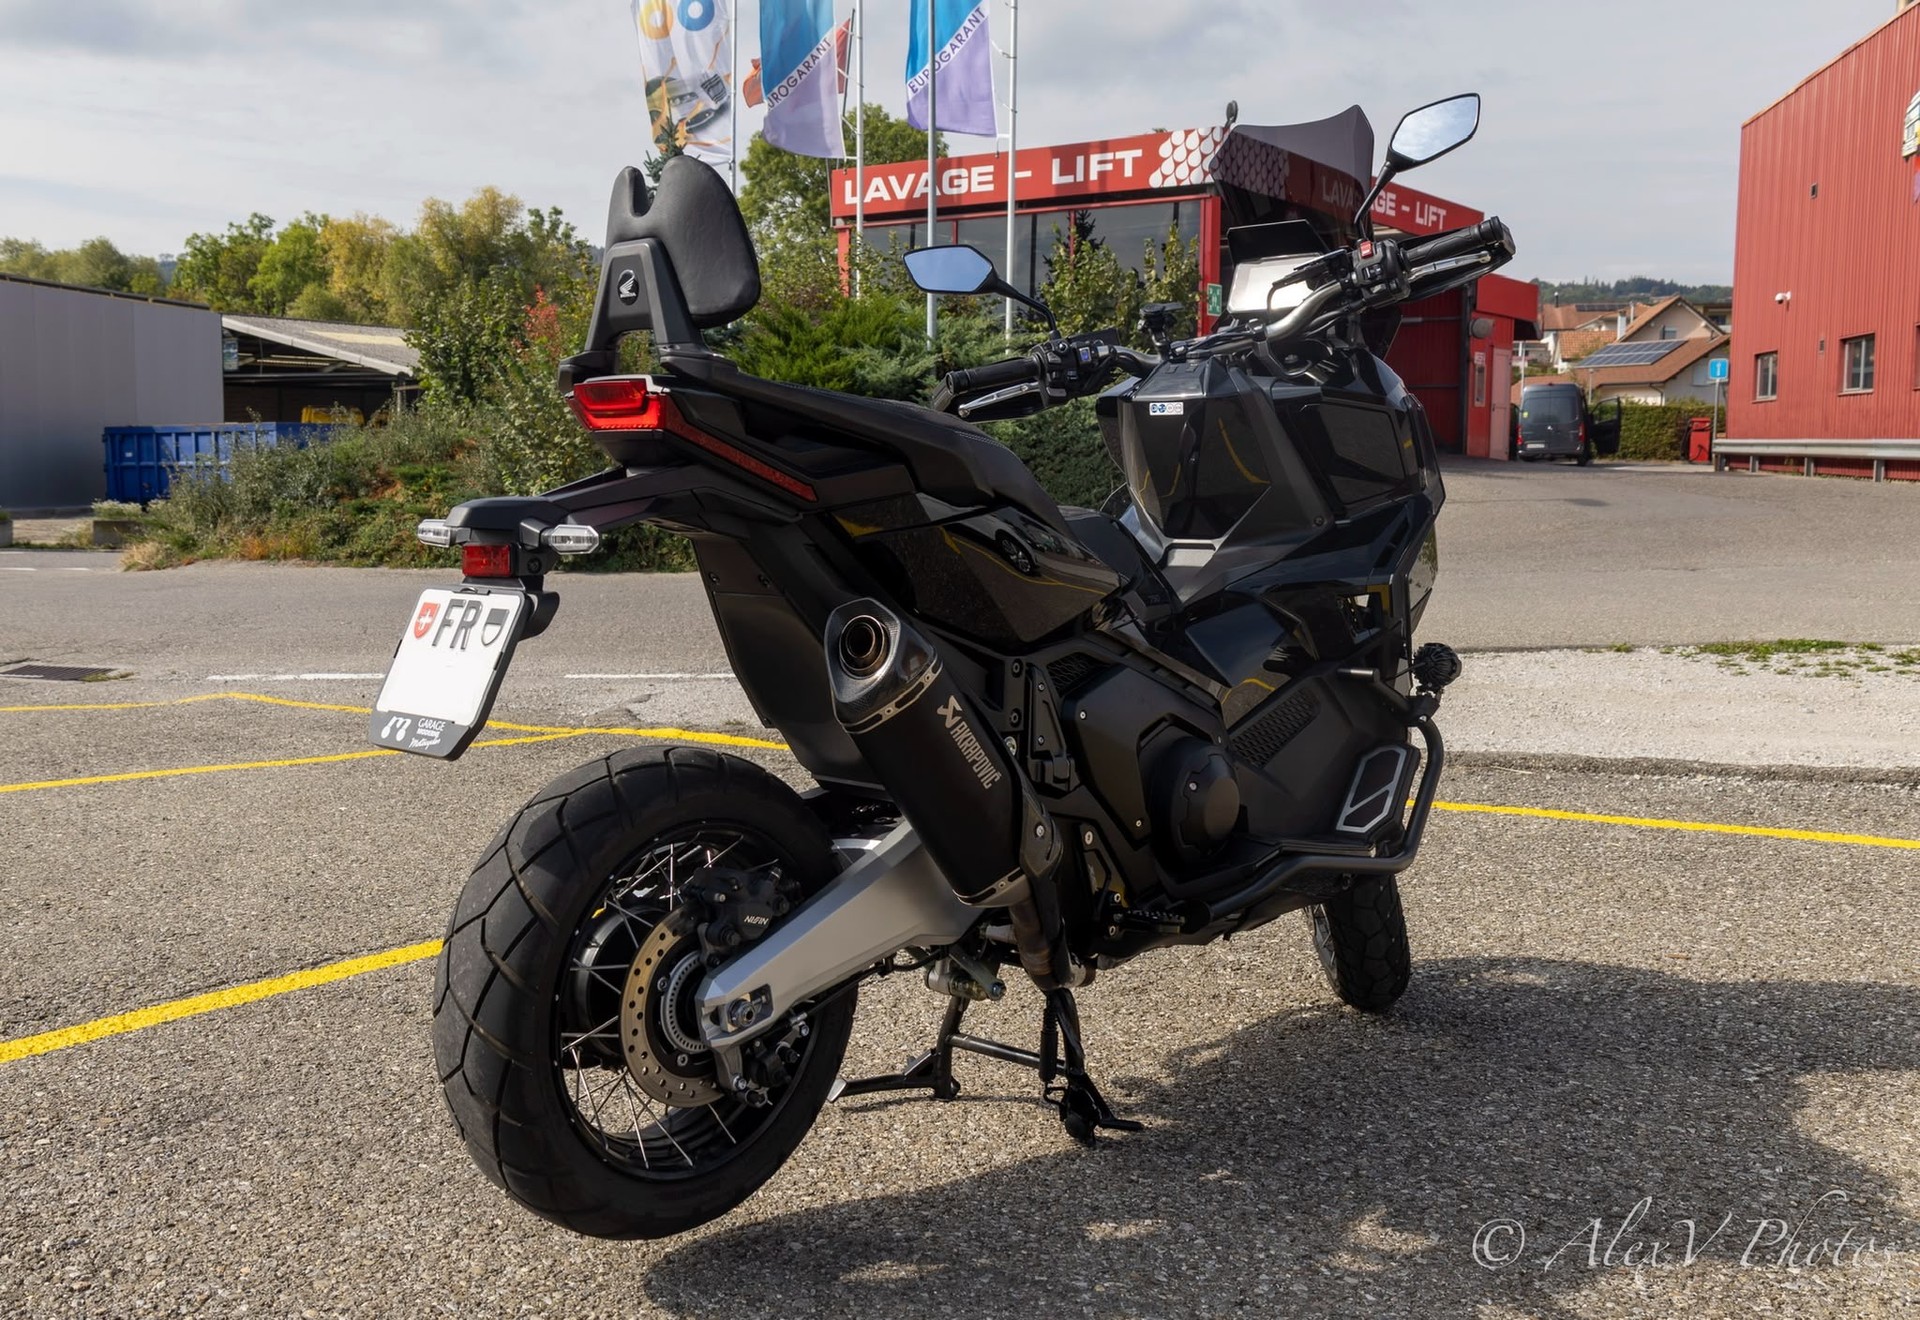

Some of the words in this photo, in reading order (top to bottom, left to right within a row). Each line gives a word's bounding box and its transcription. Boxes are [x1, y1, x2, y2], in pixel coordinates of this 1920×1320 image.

[767, 38, 831, 109] UROGARANT
[844, 165, 994, 205] LAVAGE
[1052, 149, 1142, 185] LIFT
[1415, 201, 1446, 230] LIFT
[431, 598, 484, 650] FR
[418, 718, 446, 732] GARAGE
